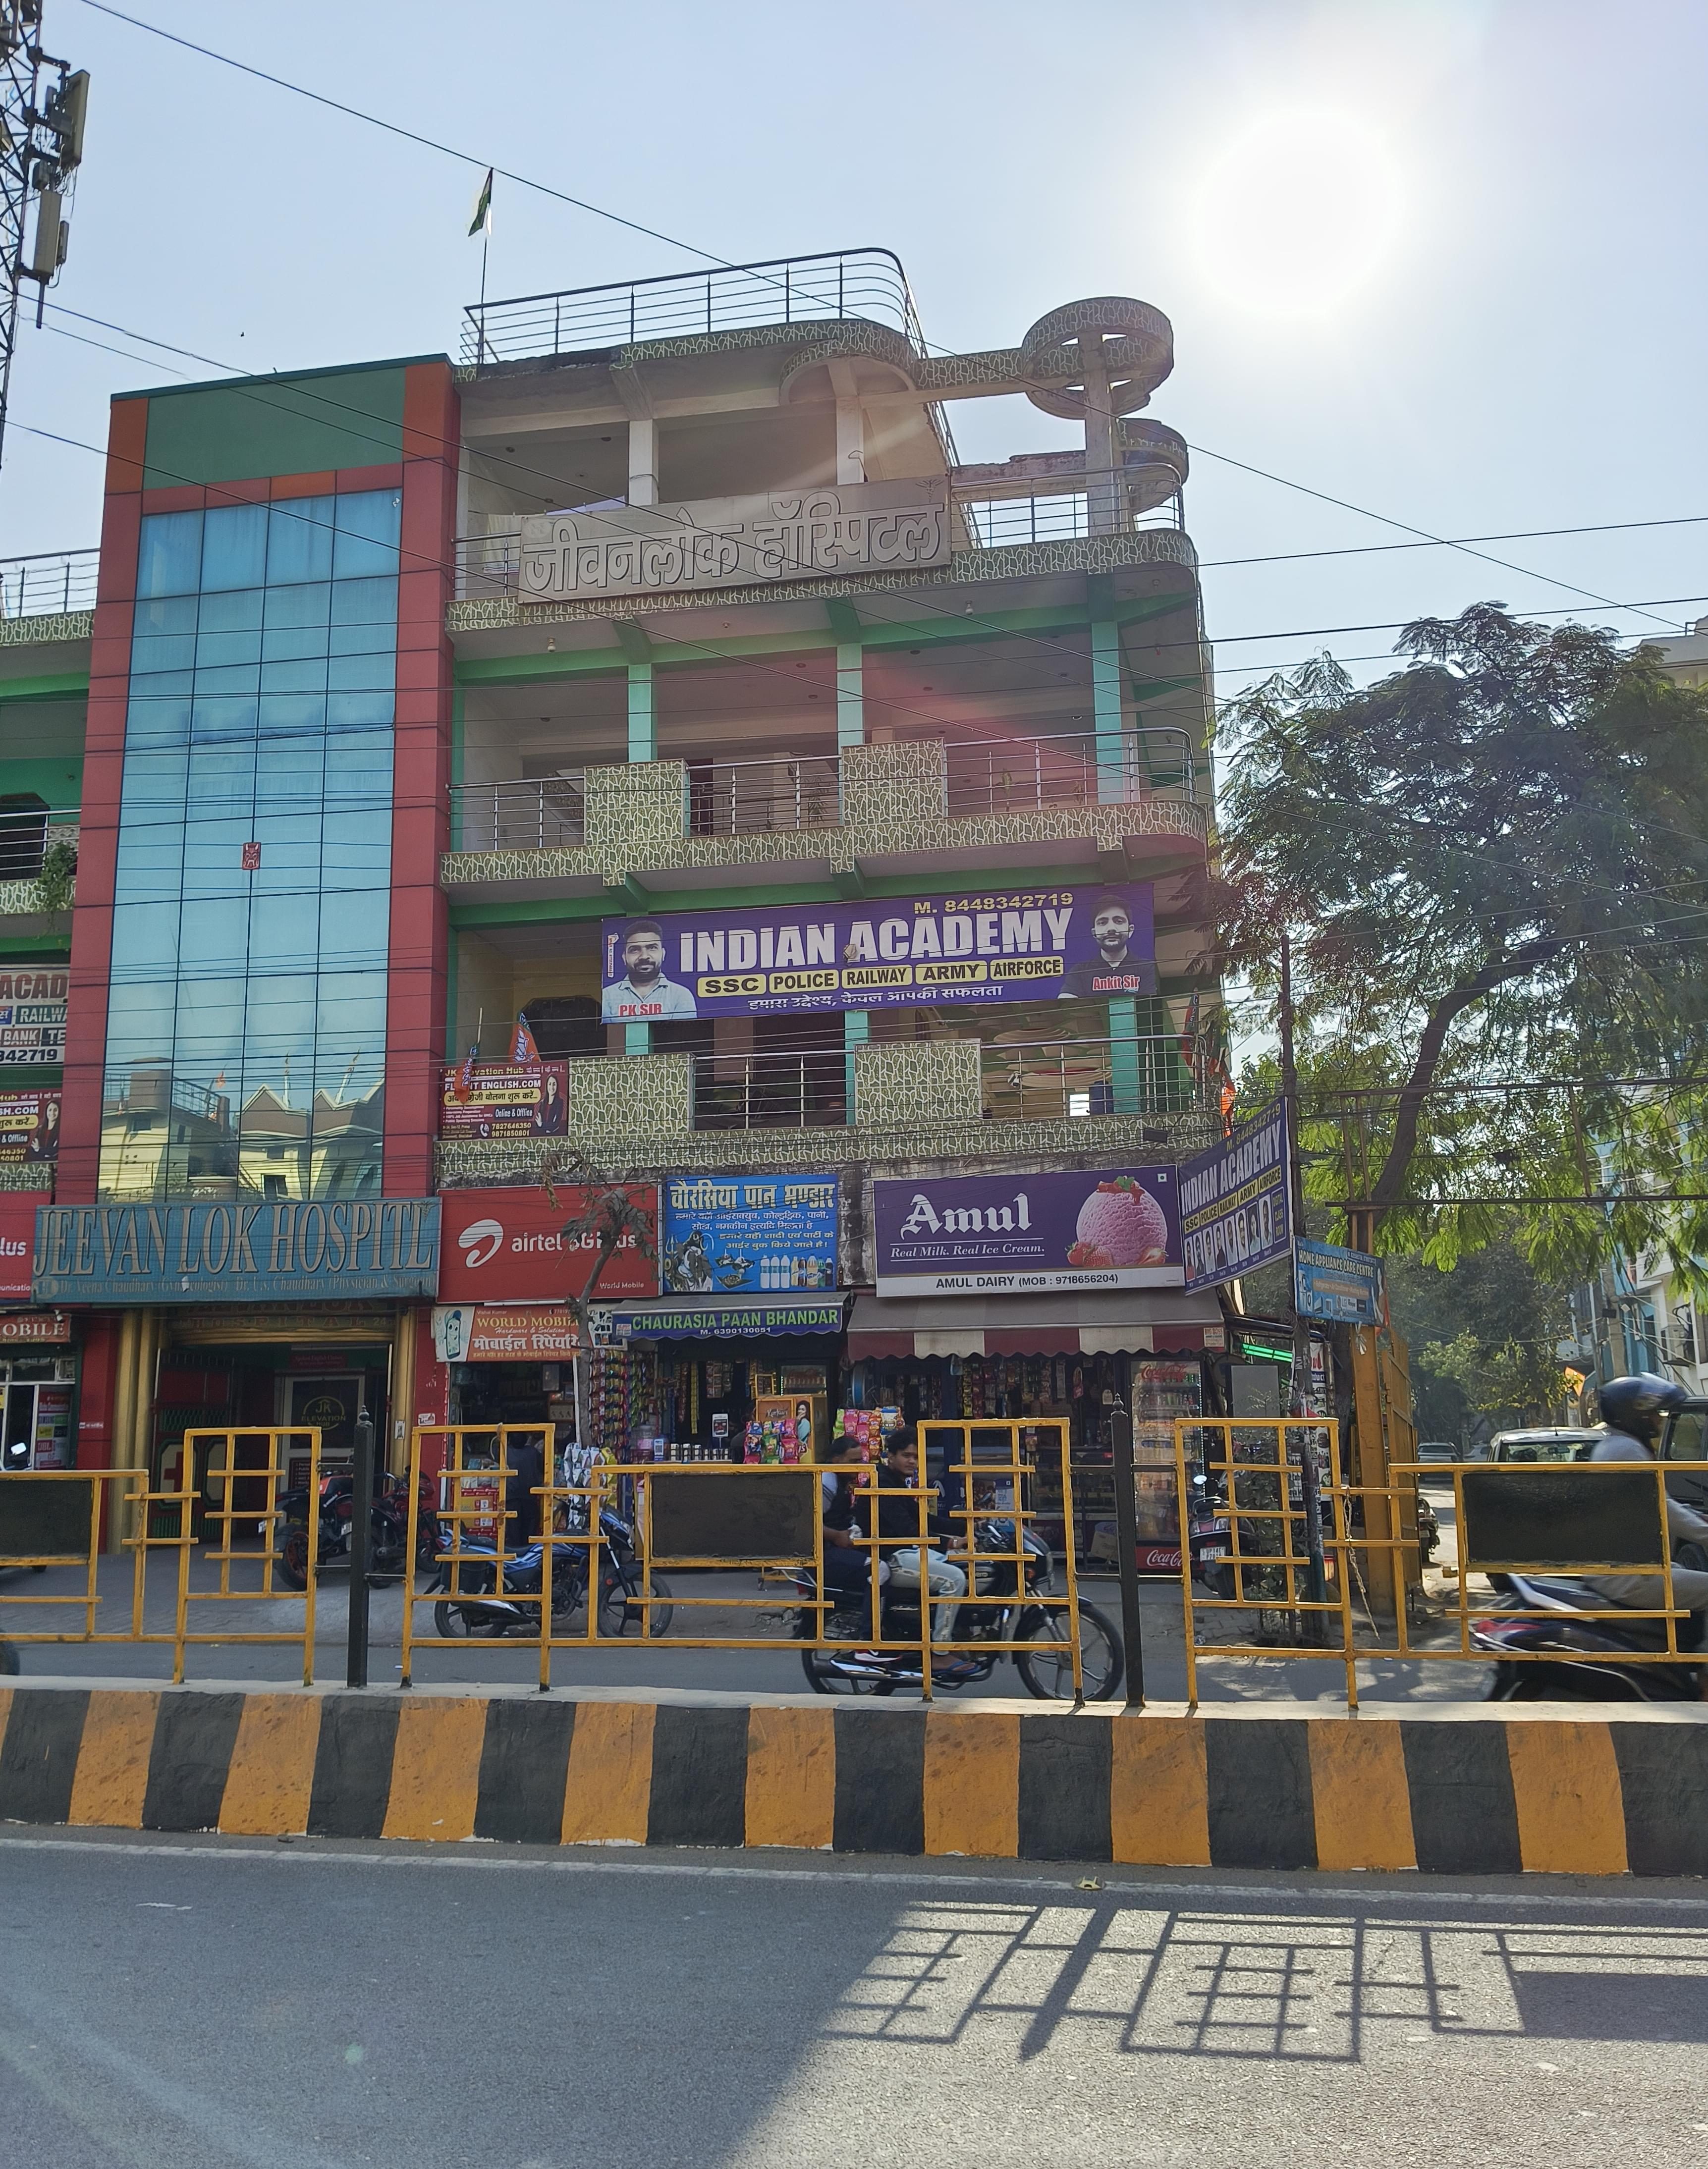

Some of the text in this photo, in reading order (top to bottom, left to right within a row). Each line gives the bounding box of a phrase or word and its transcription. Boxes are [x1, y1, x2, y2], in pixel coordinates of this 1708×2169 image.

[523, 490, 945, 592] जीवनलोक हॉस्पिटल
[914, 892, 1073, 914] M. 8448342719
[680, 908, 1074, 973] INDIAN ACADEMY
[705, 959, 1061, 994] SSC POLICE RAILWAY ARMY AIRFORCE
[1093, 976, 1140, 990] Ankit Sir
[887, 986, 937, 1002] आपकी
[941, 985, 1003, 999] सफलता
[619, 1004, 637, 1016] PK
[3, 1030, 38, 1045] BANK
[482, 1080, 541, 1090] ENGLISH.COM
[496, 1108, 510, 1117] Online
[511, 1108, 516, 1117] &
[517, 1107, 533, 1117] Offline
[1180, 1119, 1281, 1216] INDIAN ACADEMY
[670, 1179, 835, 1209] चौरसिया पान भण्डार
[1185, 1168, 1281, 1232] SSC POLICE RAILWAY ARMY AIRFORCE
[900, 1192, 1032, 1240] Amul
[33, 1201, 433, 1277] JEEVAN LOK HOSPITL
[511, 1232, 563, 1252] airtel
[890, 1242, 1045, 1258] Real Milk. Real Ice Cream.
[1299, 1249, 1315, 1266] HOME
[1316, 1253, 1343, 1272] APPLIANCE
[1343, 1259, 1356, 1274] CARE
[1356, 1263, 1374, 1278] CENTRE
[936, 1277, 973, 1289] AMUL
[976, 1275, 1015, 1288] DAIRY
[1018, 1275, 1047, 1288] (MOB
[1055, 1273, 1118, 1286] 9718656204)
[0, 1322, 64, 1336] OBILE
[477, 1317, 527, 1327] WORLD
[632, 1314, 717, 1330] CHAURASIA
[721, 1311, 761, 1327] PAAN
[766, 1309, 838, 1325] BHANDAR
